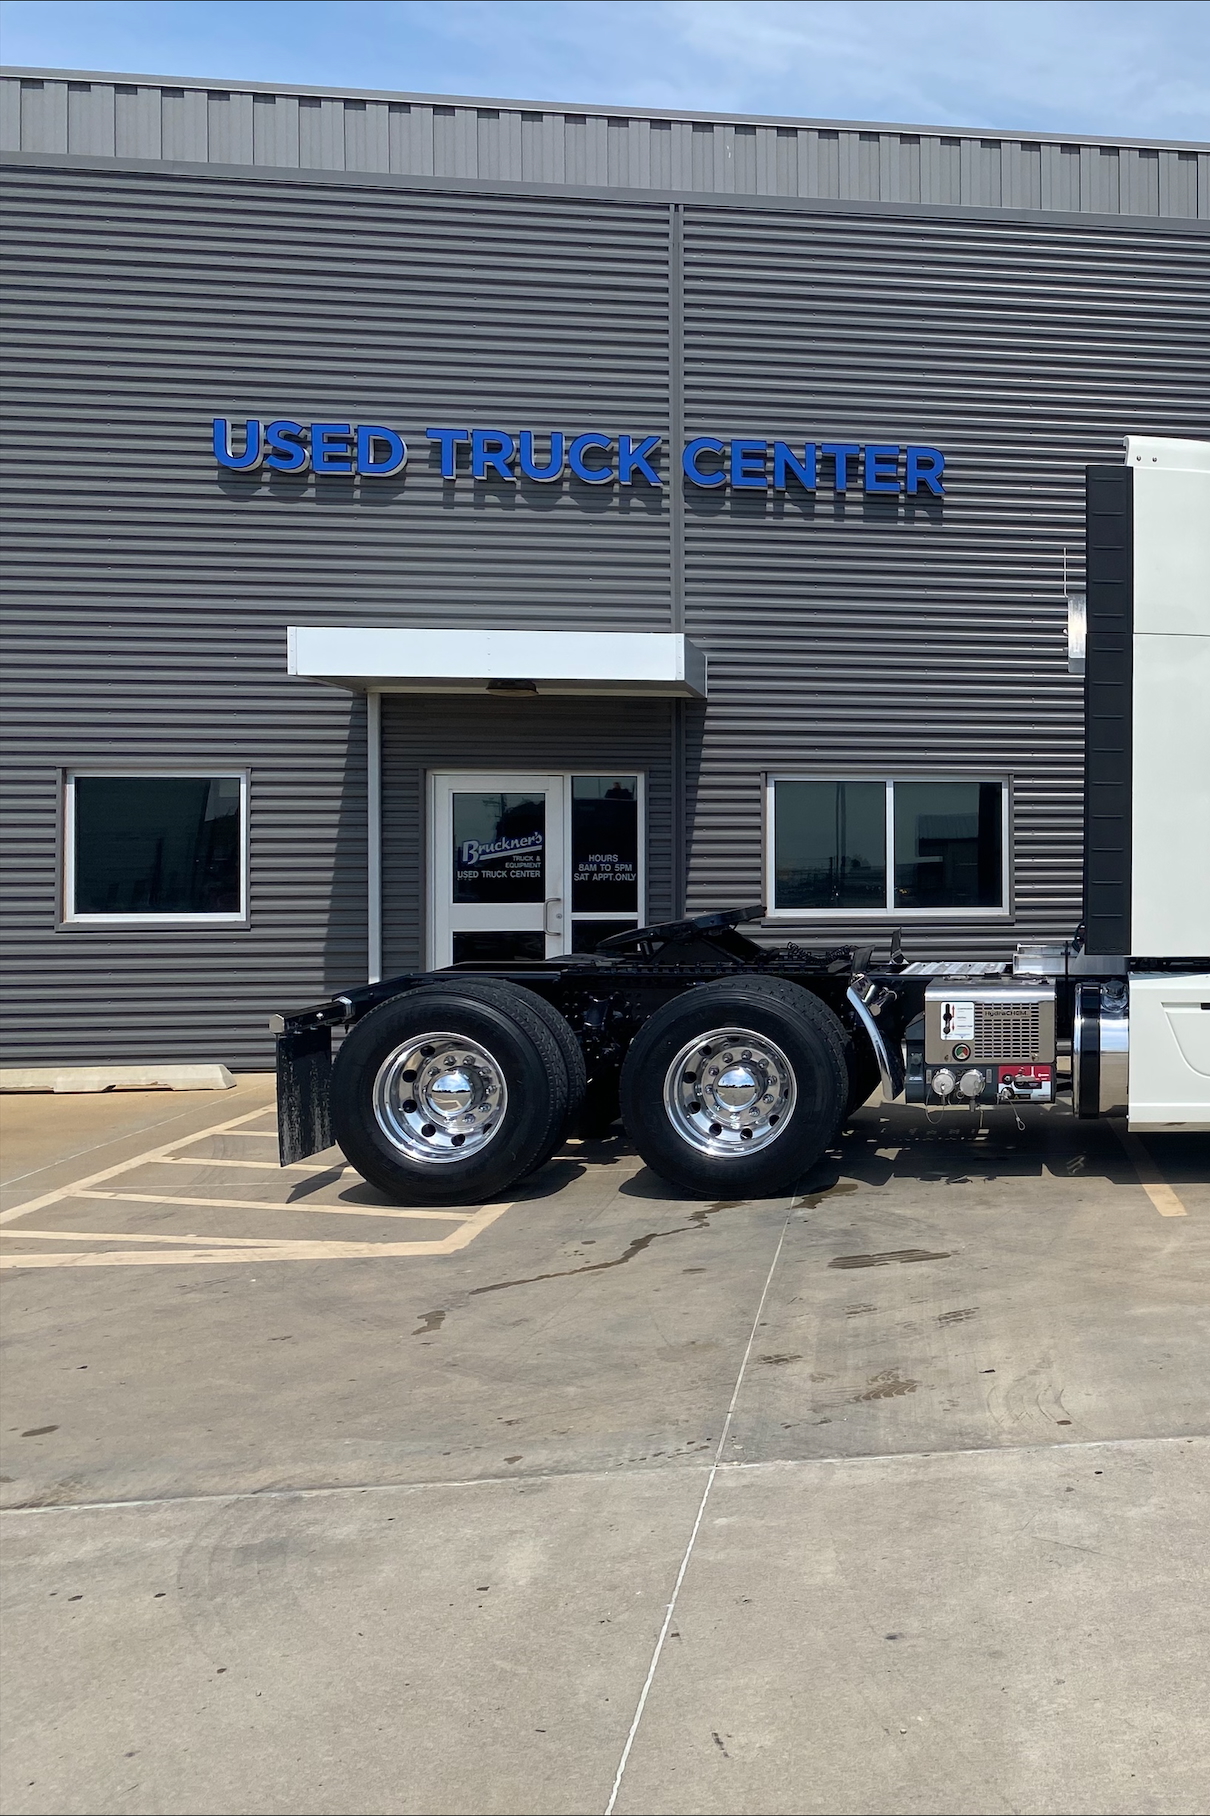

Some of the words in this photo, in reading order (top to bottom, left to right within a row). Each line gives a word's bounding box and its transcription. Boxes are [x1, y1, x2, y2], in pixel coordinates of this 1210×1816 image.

[212, 418, 406, 477] USED
[425, 428, 663, 486] TRUCK
[681, 437, 946, 495] CENTER
[462, 831, 543, 865] Bruckner's
[588, 854, 619, 862] HOURS
[578, 863, 597, 872] 8AM
[600, 863, 611, 871] TO
[614, 863, 633, 871] 5PM
[457, 870, 479, 878] USED
[481, 870, 507, 878] TRUCK
[510, 870, 541, 878] CENTER
[573, 873, 590, 881] SAT
